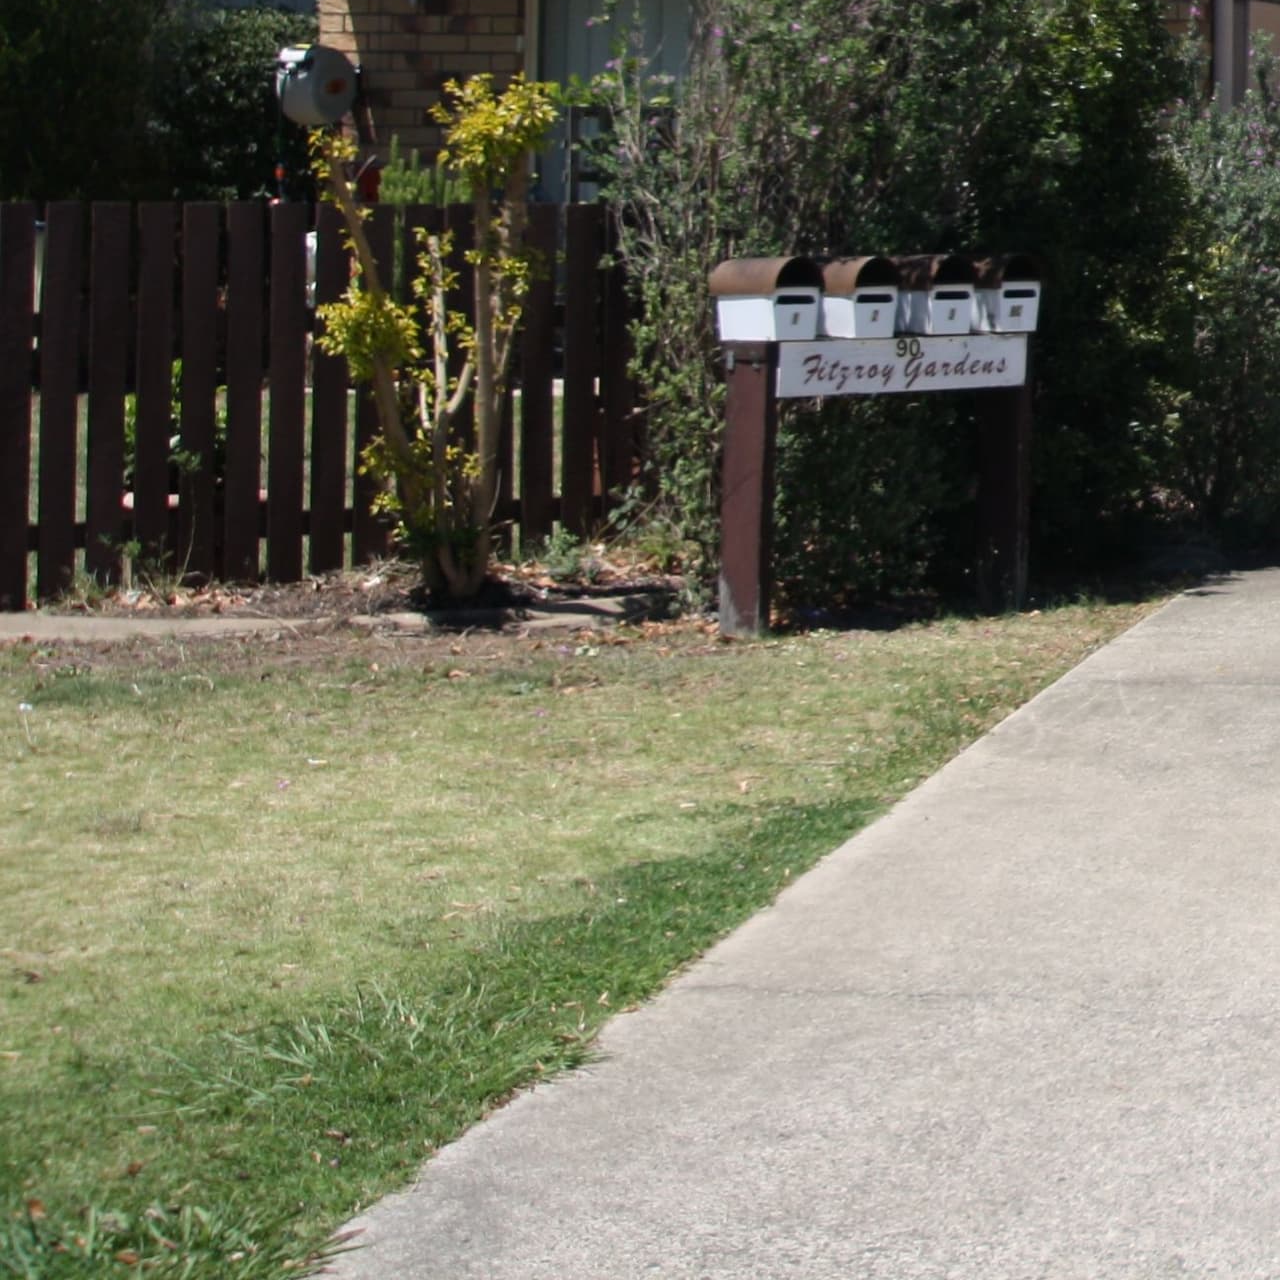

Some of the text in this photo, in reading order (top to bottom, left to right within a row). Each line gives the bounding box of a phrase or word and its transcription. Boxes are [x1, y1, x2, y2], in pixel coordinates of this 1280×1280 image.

[896, 338, 920, 357] 90
[803, 351, 1008, 390] Fitzroy Gardens
